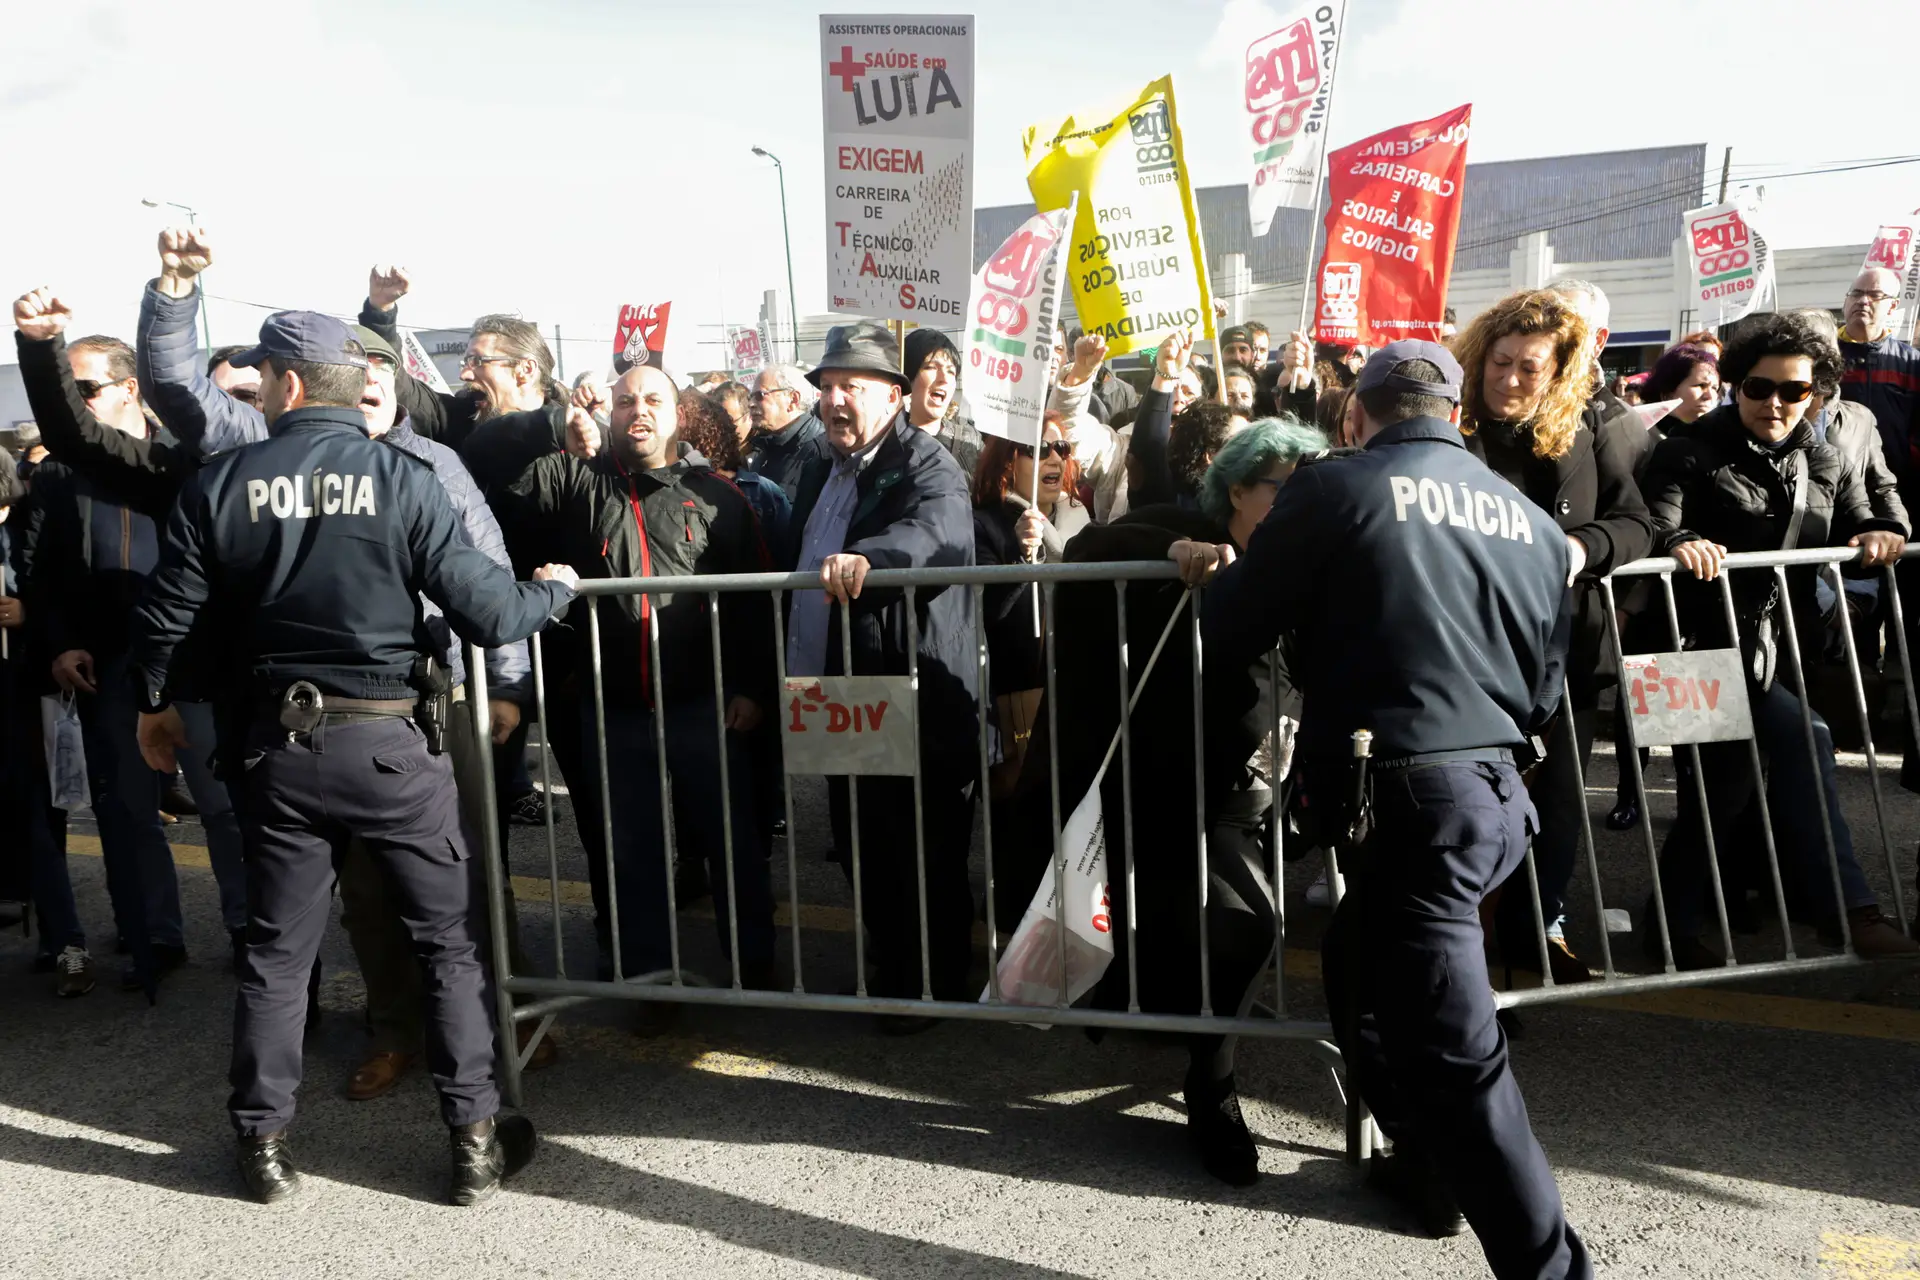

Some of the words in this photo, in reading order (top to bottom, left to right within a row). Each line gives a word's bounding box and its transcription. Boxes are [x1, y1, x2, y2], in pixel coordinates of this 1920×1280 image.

[828, 24, 891, 36] ASSISTENTES
[893, 25, 967, 37] OPERACIONAIS
[864, 48, 918, 69] SAÚDE
[922, 56, 947, 70] em
[852, 66, 962, 126] LUTA
[838, 146, 924, 175] EXIGEM
[835, 185, 911, 203] CARREIRA
[864, 205, 883, 220] DE
[834, 221, 914, 252] TÉCNICO
[859, 251, 941, 285] AUXILIAR
[899, 284, 961, 316] SAÚDE
[247, 467, 377, 523] POLÍCIA
[1389, 476, 1534, 545] POLÍCIA
[1662, 676, 1721, 711] DIV
[824, 701, 888, 733] DIV
